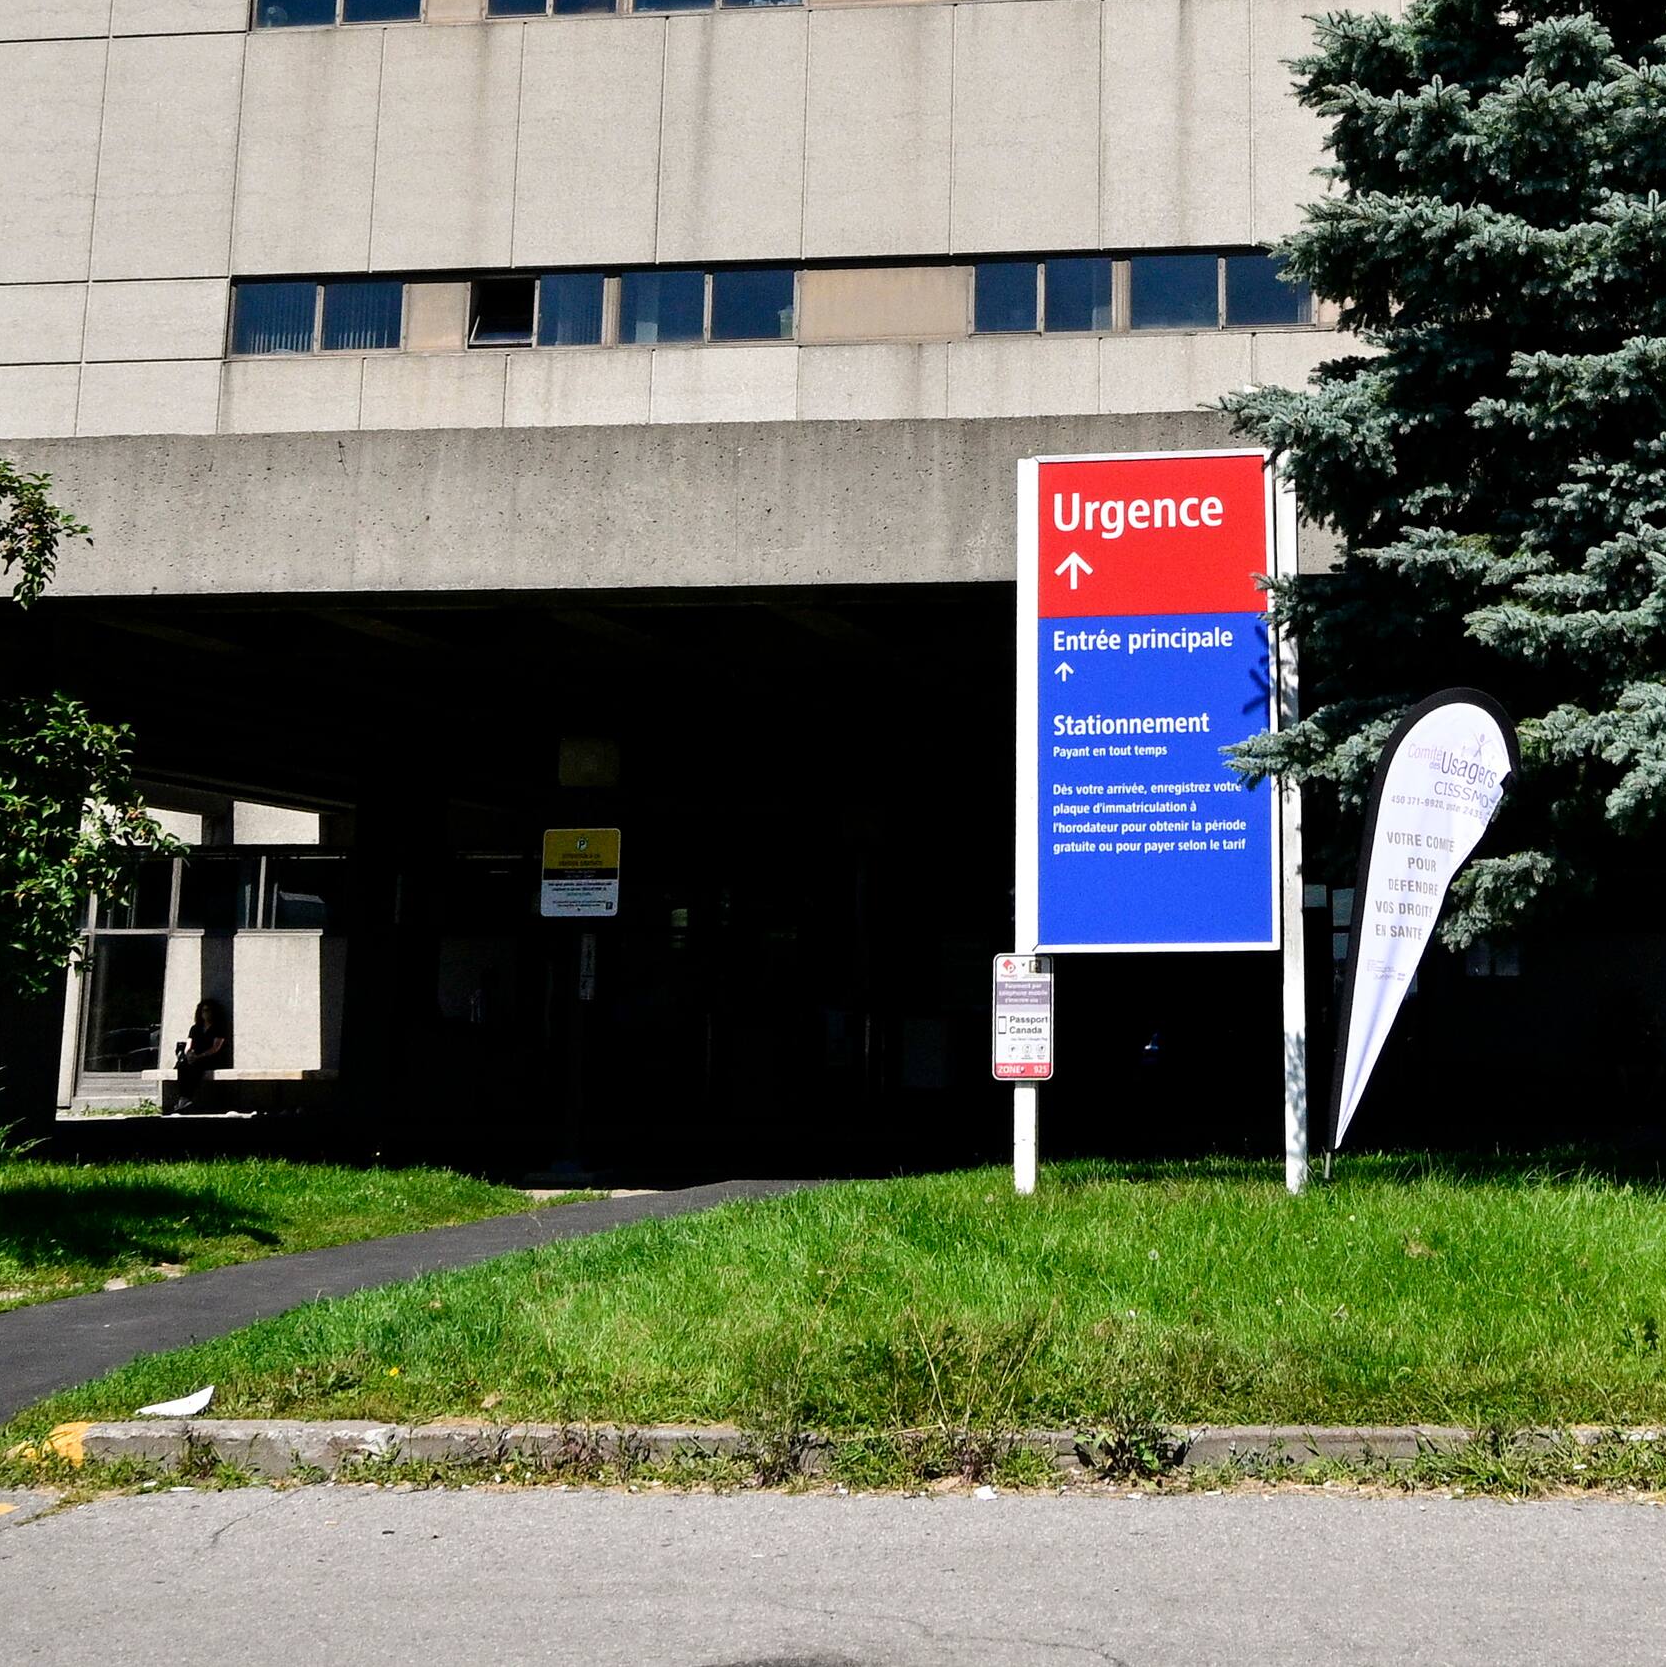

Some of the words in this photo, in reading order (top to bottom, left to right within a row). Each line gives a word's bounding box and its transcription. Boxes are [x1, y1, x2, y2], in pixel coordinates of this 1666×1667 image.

[1053, 492, 1224, 539] Urgence
[1053, 629, 1121, 651] Entrée
[1128, 626, 1233, 654] principale
[1053, 713, 1210, 736] Stationnement
[1053, 745, 1090, 759] Payant
[1092, 747, 1106, 756] en
[1109, 745, 1131, 756] tout
[1134, 745, 1168, 760] temps
[1441, 751, 1497, 789] Usagers
[1053, 783, 1073, 795] Dès
[1076, 783, 1104, 795] votre
[1106, 782, 1147, 795] arrivée,
[1151, 781, 1211, 794] enregistrez
[1213, 781, 1242, 792] votre
[1053, 802, 1090, 816] plaque
[1092, 801, 1187, 814] d'immatriculation
[1190, 800, 1197, 812] à
[1053, 821, 1118, 833] l'horodateur
[1121, 822, 1147, 834] pour
[1149, 820, 1189, 832] obtenir
[1192, 820, 1202, 831] la
[1205, 819, 1247, 833] période
[1053, 841, 1096, 854] gratuite
[1099, 843, 1113, 852] ou
[1116, 842, 1141, 854] pour
[1144, 841, 1175, 853] payer
[1177, 839, 1207, 851] selon
[1210, 839, 1220, 850] le
[1223, 838, 1246, 850] tarif
[1387, 831, 1422, 847] VOTRE
[1407, 857, 1437, 873] POUR
[1375, 900, 1394, 914] VOS
[1399, 902, 1433, 919] DROITS
[1375, 923, 1386, 937] EN
[1009, 1016, 1049, 1025] Passport
[1009, 1025, 1042, 1034] Canada
